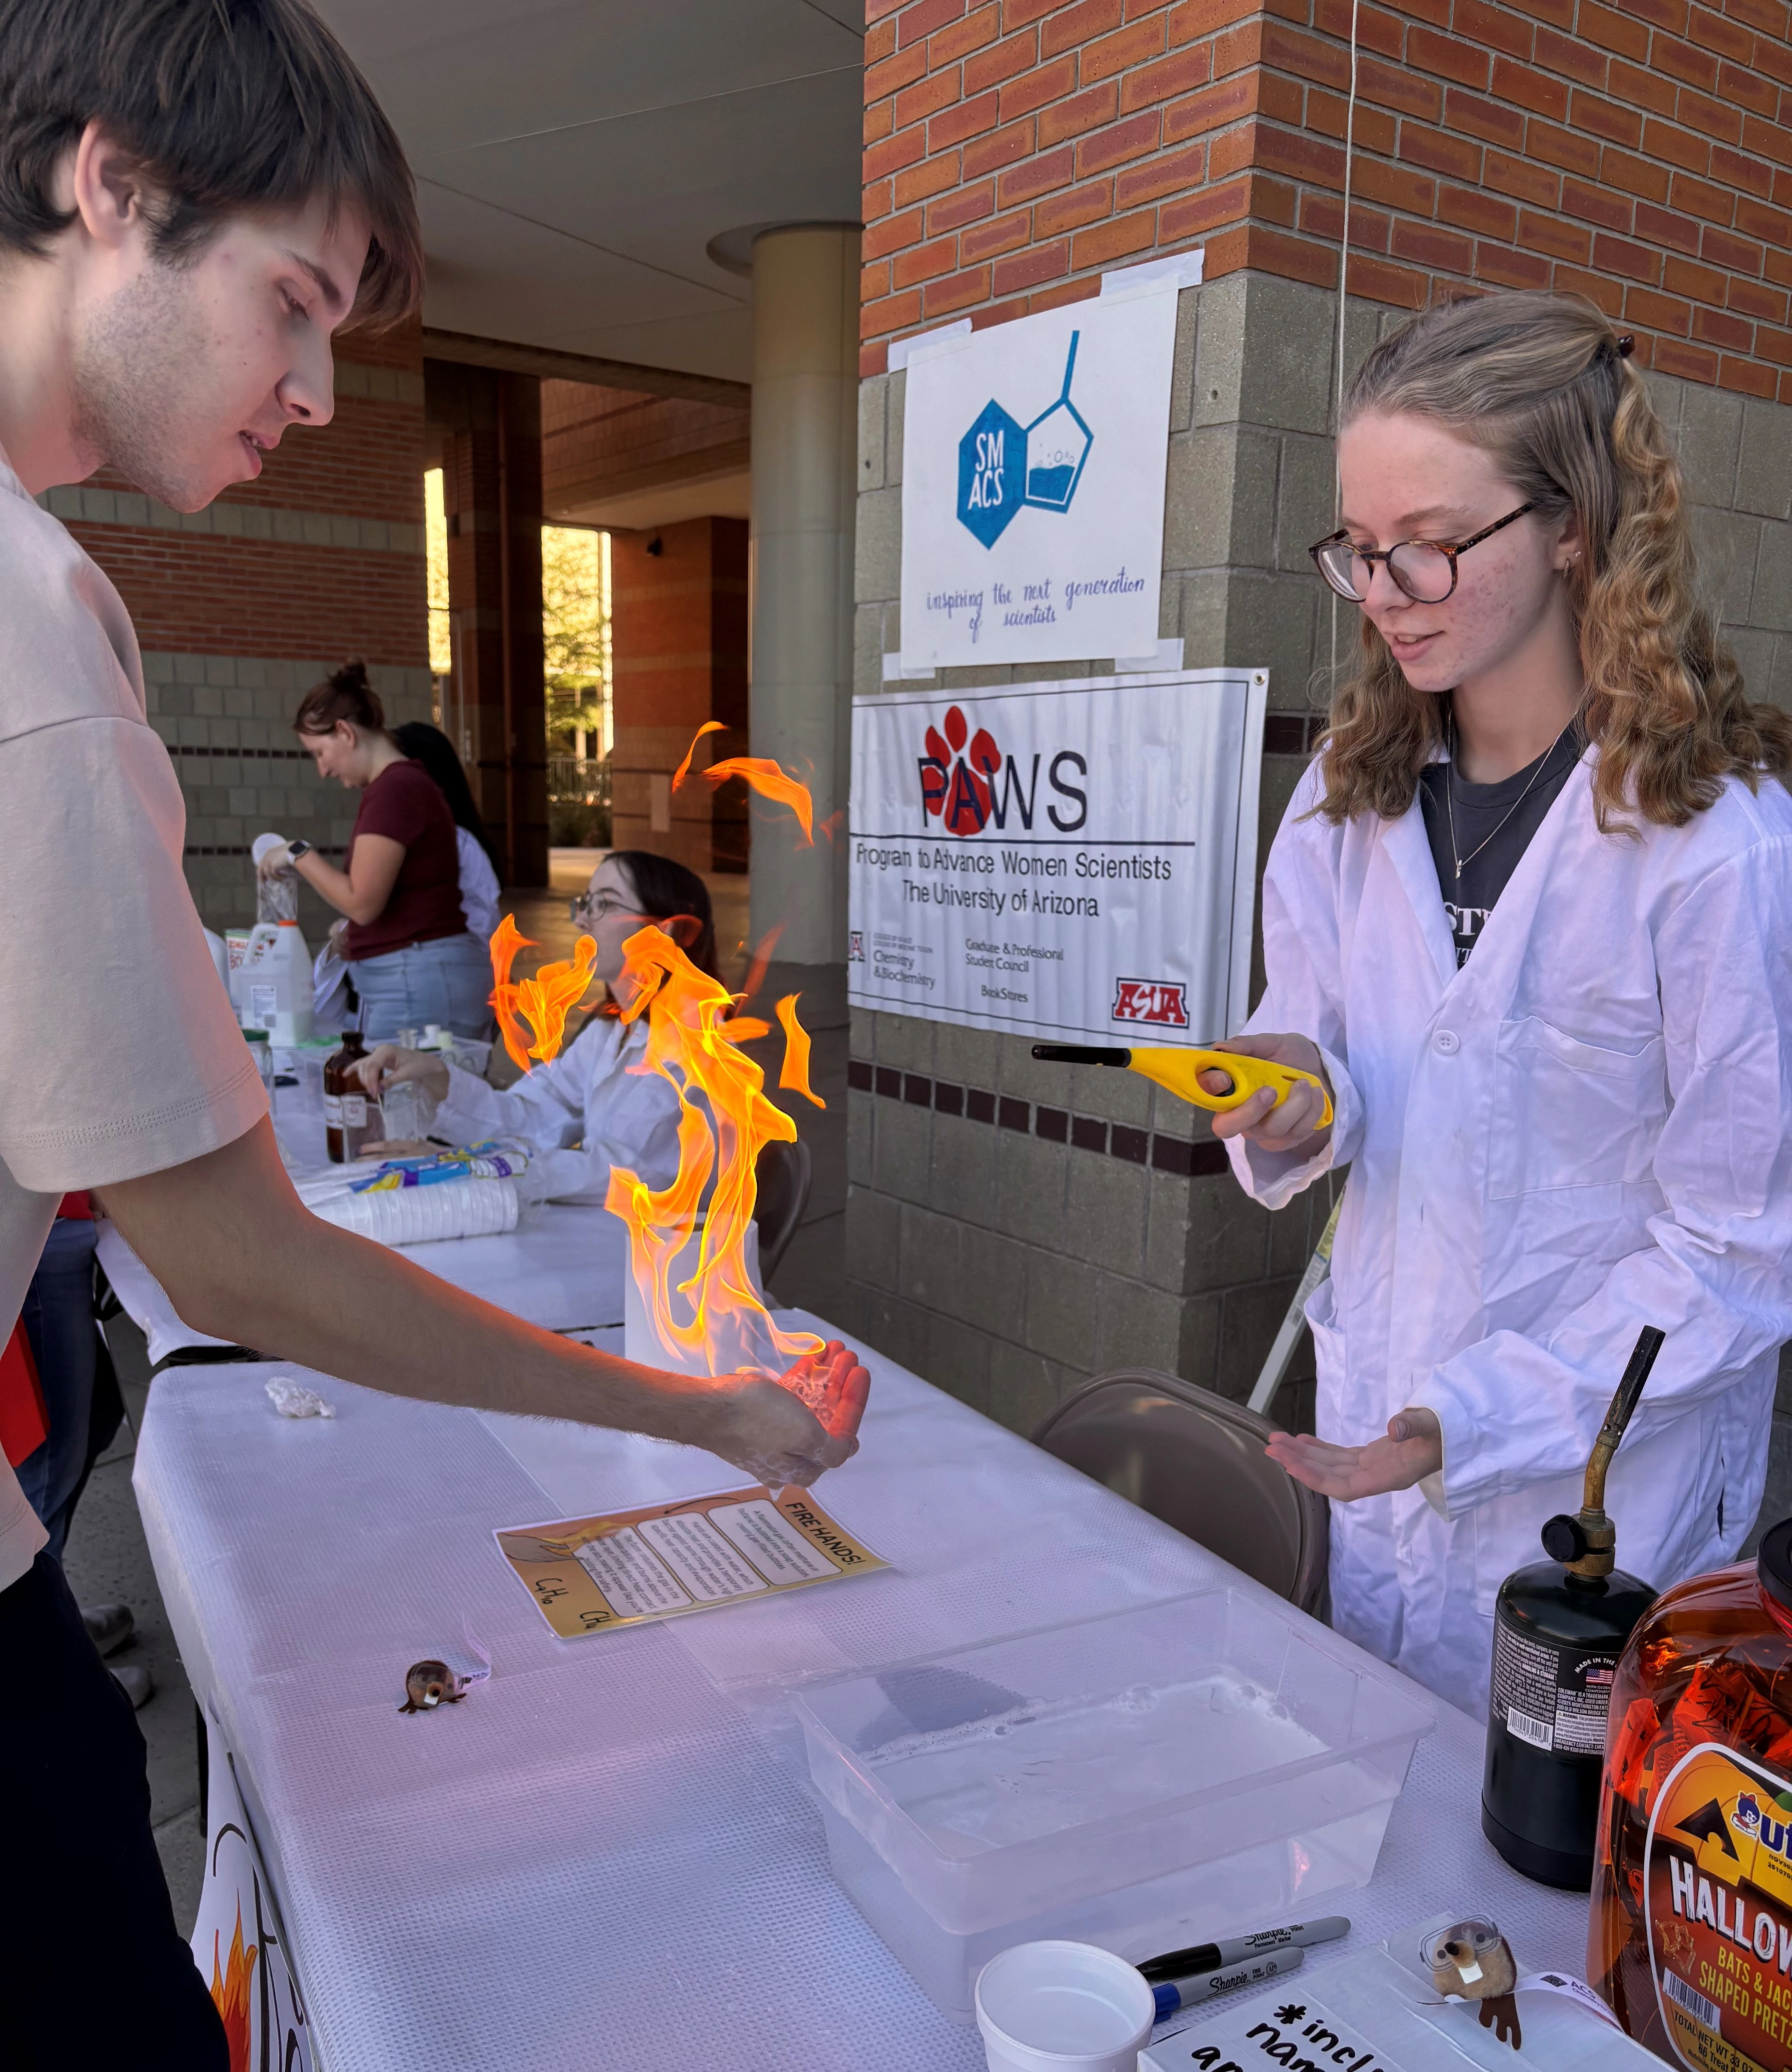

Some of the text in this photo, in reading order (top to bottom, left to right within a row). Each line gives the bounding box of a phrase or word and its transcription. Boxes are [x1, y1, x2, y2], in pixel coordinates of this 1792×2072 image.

[975, 430, 1004, 472] SM
[968, 468, 1004, 510] ACS
[927, 565, 1145, 620] inspiring the next generation
[969, 604, 1057, 643] of scientists
[917, 751, 1087, 832] PAWS
[918, 848, 931, 868] to
[934, 848, 995, 874] Advance
[1001, 851, 1067, 877] Women
[1075, 852, 1172, 880] Scientists
[903, 879, 1100, 917] The University of Arizona
[996, 958, 1029, 972] Council
[1003, 943, 1011, 955] &
[1012, 944, 1064, 961] Professional
[786, 1502, 866, 1565] FIRE HANDS!
[1574, 1659, 1592, 1673] MADE
[1557, 1693, 1577, 1702] COMPANY,
[1572, 1702, 1599, 1710] WORTHINGTON
[1554, 1737, 1575, 1747] EMERGENCY
[1571, 1981, 1596, 1999] ACS
[1699, 1961, 1749, 2017] SHAPED
[1718, 1945, 1792, 2014] BATS & JAC
[1674, 2010, 1696, 2036] TOTAL
[1699, 2031, 1714, 2048] NET
[1716, 2042, 1728, 2059] WT
[1730, 2054, 1740, 2067] 33
[1698, 2043, 1728, 2072] 66 Treat
